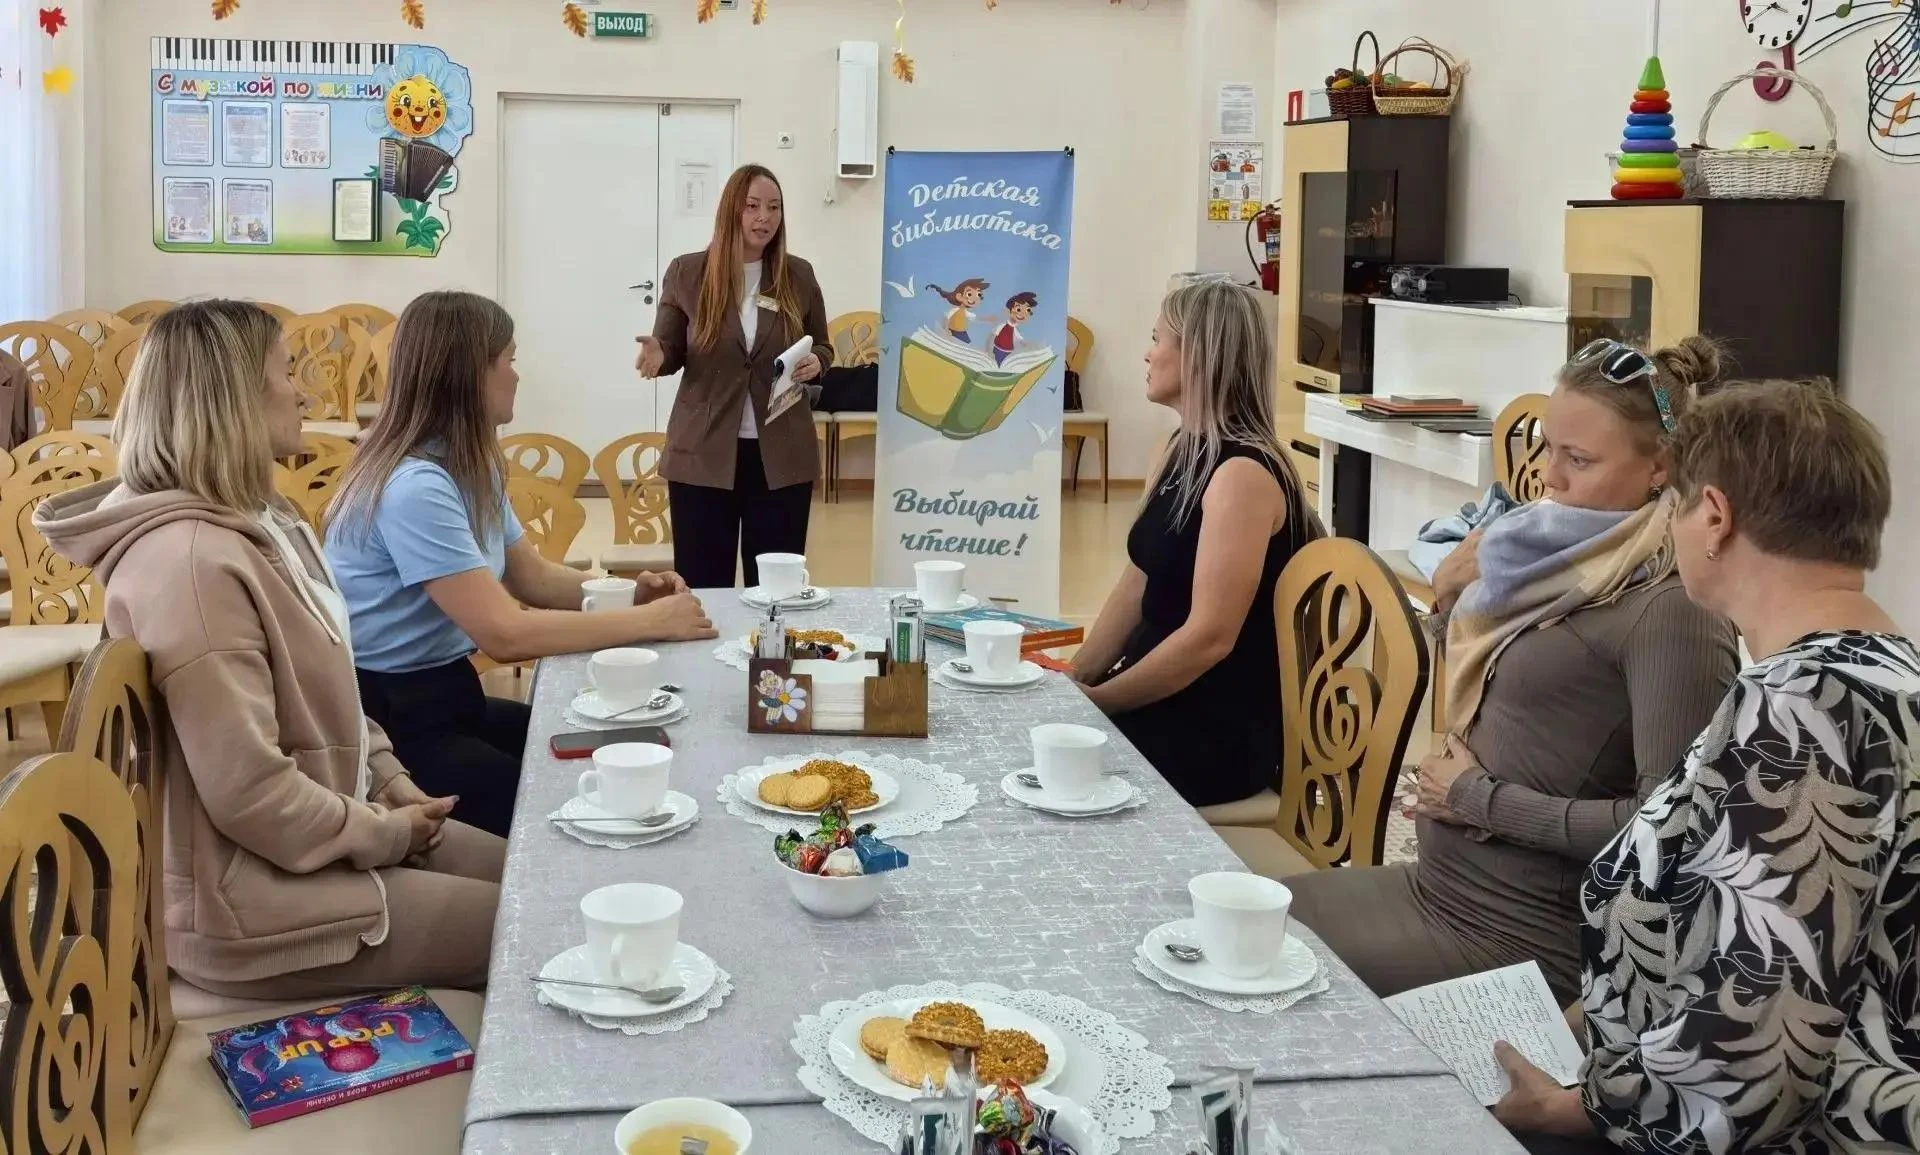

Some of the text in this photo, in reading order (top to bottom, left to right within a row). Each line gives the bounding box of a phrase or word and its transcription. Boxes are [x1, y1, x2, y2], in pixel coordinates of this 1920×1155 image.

[1745, 6, 1751, 15] 9
[597, 16, 644, 33] ВЫХОД
[1797, 14, 1803, 25] 4
[1747, 23, 1754, 33] 8
[1759, 34, 1765, 45] 7
[1772, 36, 1779, 46] 6
[157, 73, 173, 91] С
[284, 81, 311, 95] по
[908, 176, 1040, 208] Детская
[891, 209, 1062, 250] библиотека
[893, 488, 1040, 526] Выбирай
[900, 528, 1028, 556] чтение!
[278, 1021, 395, 1061] POP UP
[347, 1086, 367, 1098] МОРЯ
[306, 1095, 337, 1108] ОКЕАНЫ
